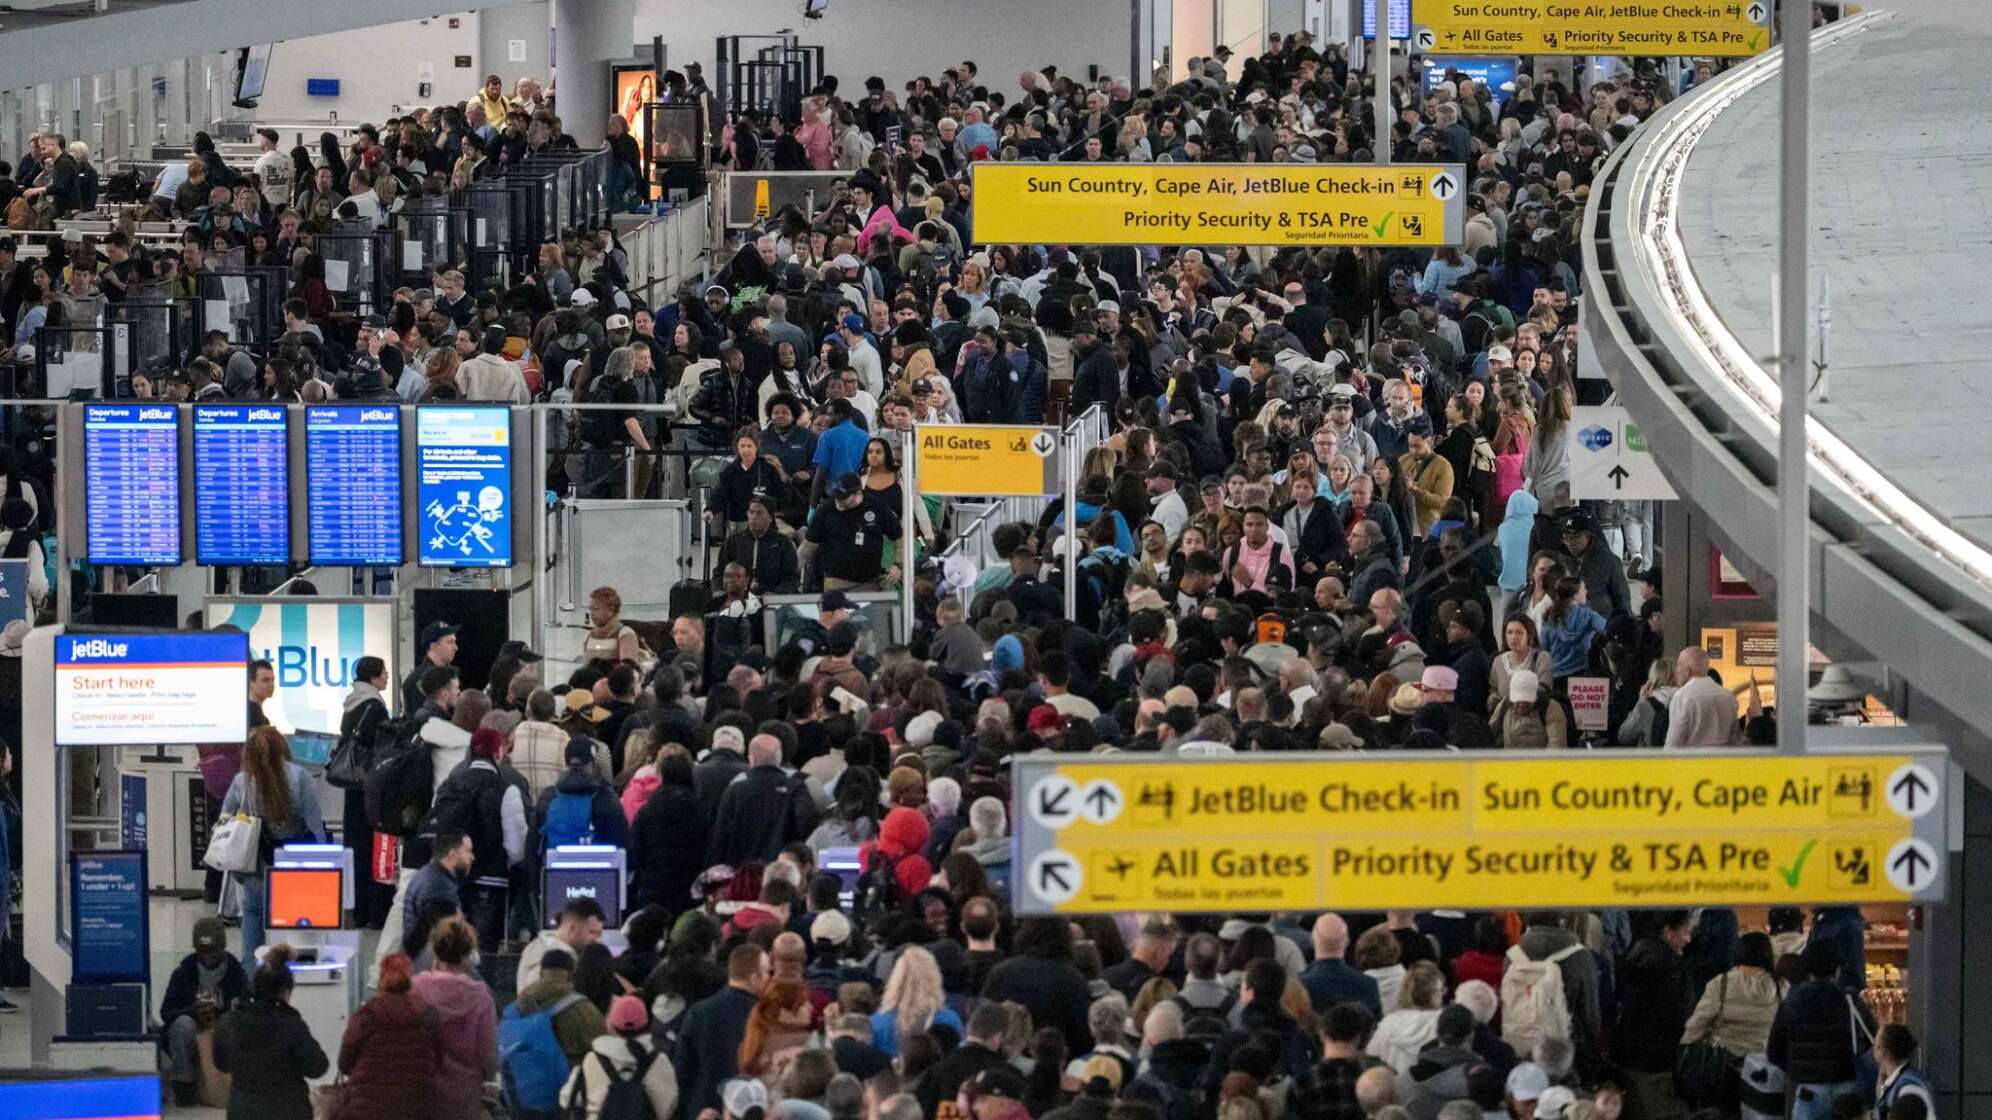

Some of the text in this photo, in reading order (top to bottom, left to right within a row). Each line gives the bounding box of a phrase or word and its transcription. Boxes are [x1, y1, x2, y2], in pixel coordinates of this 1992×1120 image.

[1453, 5, 1721, 20] Sun Country, Cape Air, JetBlue Check-in
[1462, 30, 1523, 42] All Gates
[1565, 31, 1744, 45] Priority Security & TSA Pre
[1028, 177, 1395, 198] Sun Country, Cape Air, JetBlue Check-in
[1124, 211, 1369, 231] Priority Security & TSA Pre
[1285, 231, 1369, 241] Seguridad Prioritaria
[89, 409, 130, 418] Departures
[139, 408, 173, 420] jetBlue
[198, 409, 239, 418] Departures
[248, 409, 282, 421] jetBlue
[311, 410, 338, 418] Arrivals
[361, 410, 394, 423] jetBlue
[924, 436, 991, 450] All Gates
[71, 640, 128, 661] jetBlue
[72, 676, 155, 690] Start here
[1572, 685, 1605, 693] PLEASE
[1571, 694, 1605, 702] DO NOT
[1574, 702, 1602, 710] ENTER
[72, 711, 128, 722] Comenzar
[1189, 782, 1460, 815] JetBlue Check-in
[1484, 777, 1823, 817] Sun Country, Cape Air
[1152, 849, 1310, 878] All Gates
[1333, 842, 1771, 882] Priority Security & TSA Pre
[566, 886, 596, 899] Hello!
[1613, 878, 1771, 896] Seguridad Prioritaria
[1153, 886, 1197, 901] Todas
[1225, 887, 1284, 903] puertas
